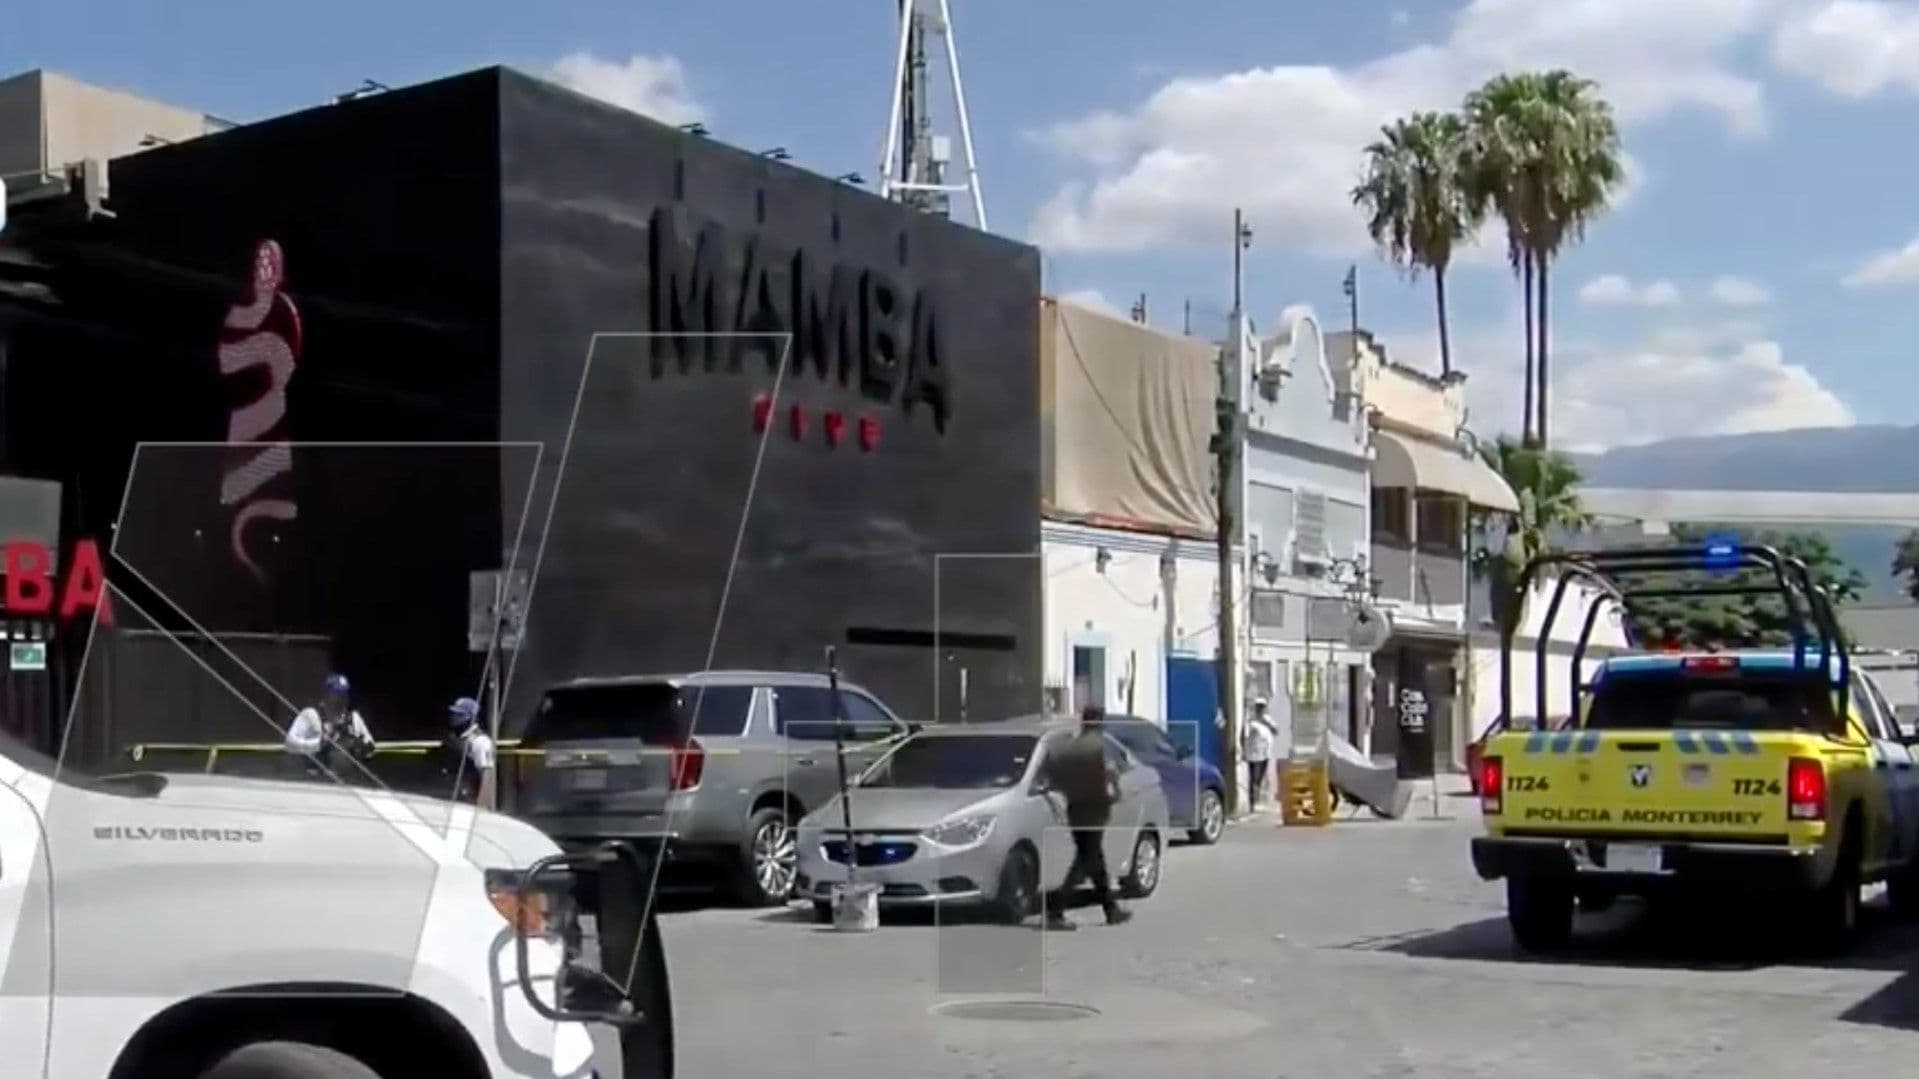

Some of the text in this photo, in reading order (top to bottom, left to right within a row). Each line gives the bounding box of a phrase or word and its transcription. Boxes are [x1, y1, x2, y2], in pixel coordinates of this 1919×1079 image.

[649, 207, 951, 435] MAMBA
[1507, 776, 1550, 792] 1124
[1733, 779, 1782, 796] 1124
[1525, 807, 1763, 825] POLICIA MONTERREY
[93, 826, 263, 843] SILVERADO
